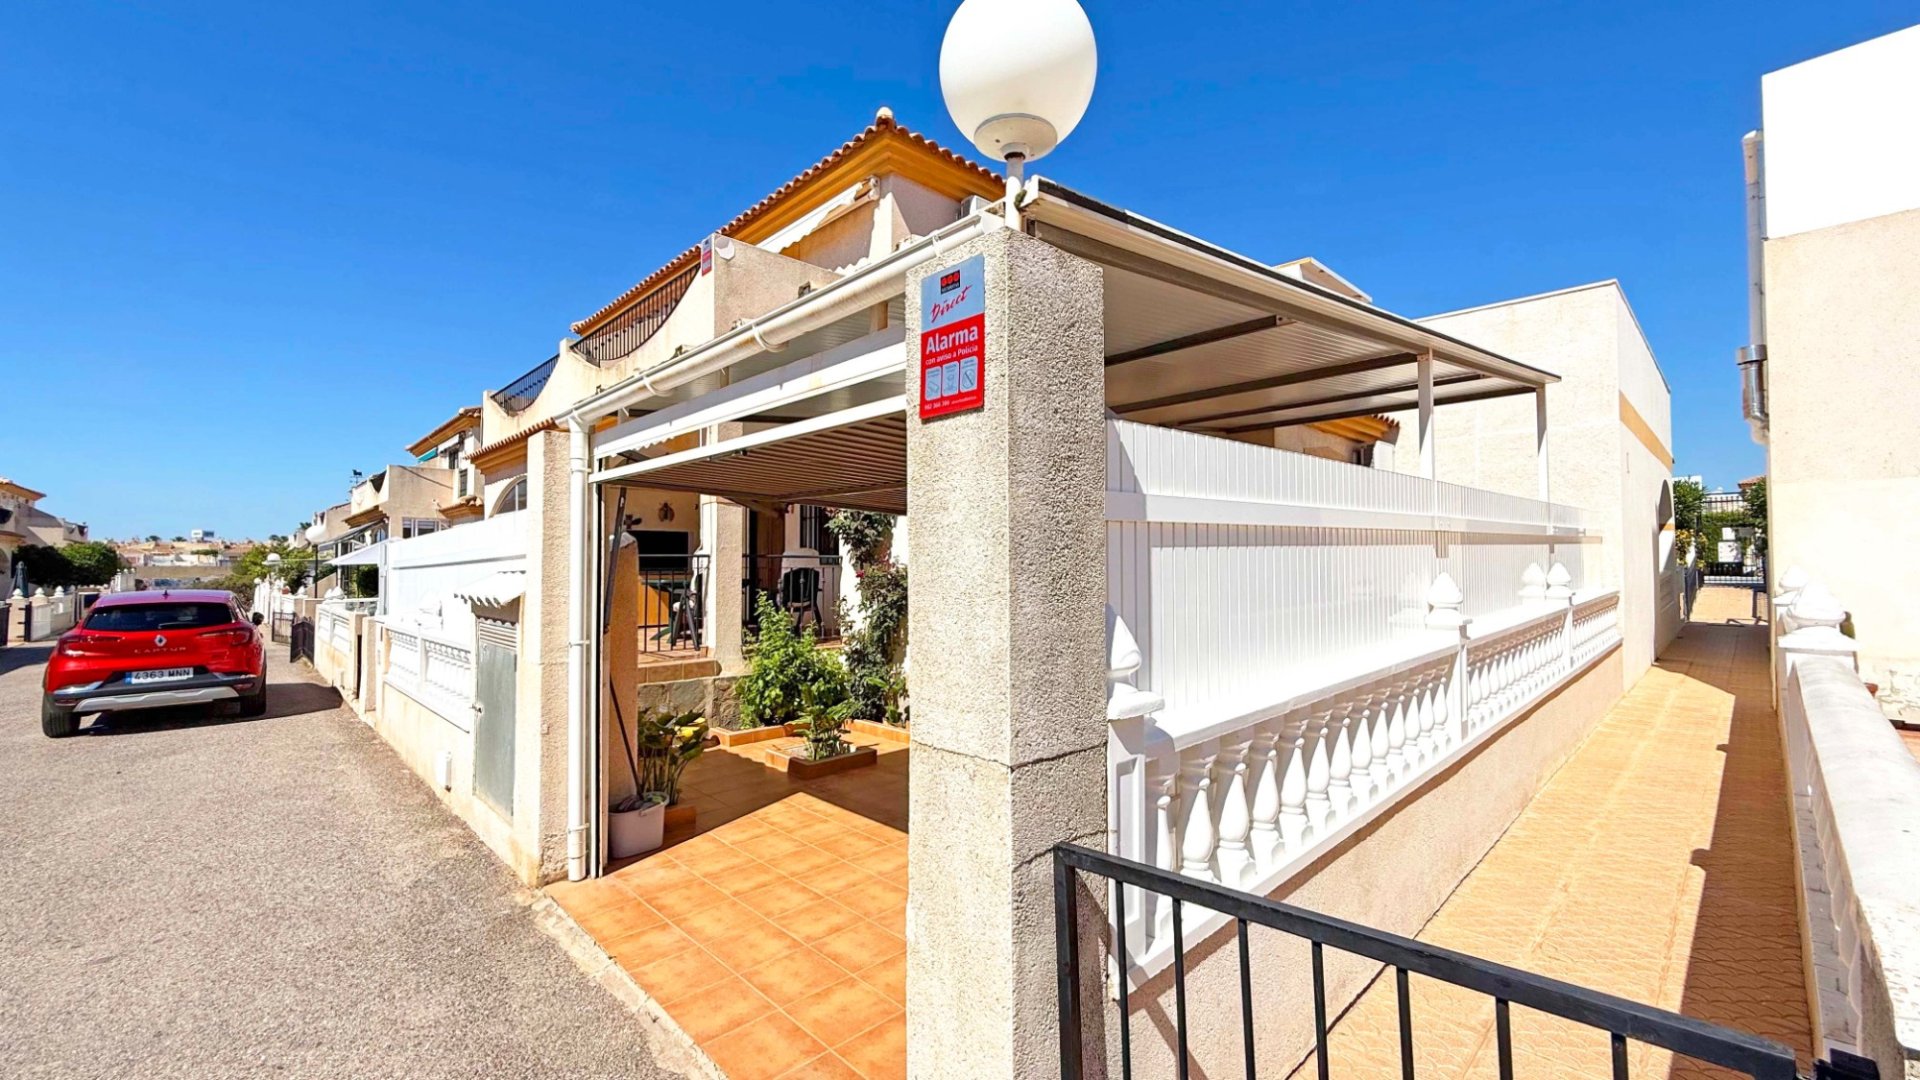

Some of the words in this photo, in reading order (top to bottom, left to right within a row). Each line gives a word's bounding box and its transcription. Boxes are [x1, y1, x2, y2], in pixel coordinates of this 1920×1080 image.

[931, 285, 972, 323] Direct
[926, 326, 978, 355] Alarma
[936, 352, 952, 362] aviso
[134, 671, 164, 680] 4363
[168, 669, 190, 677] MNN
